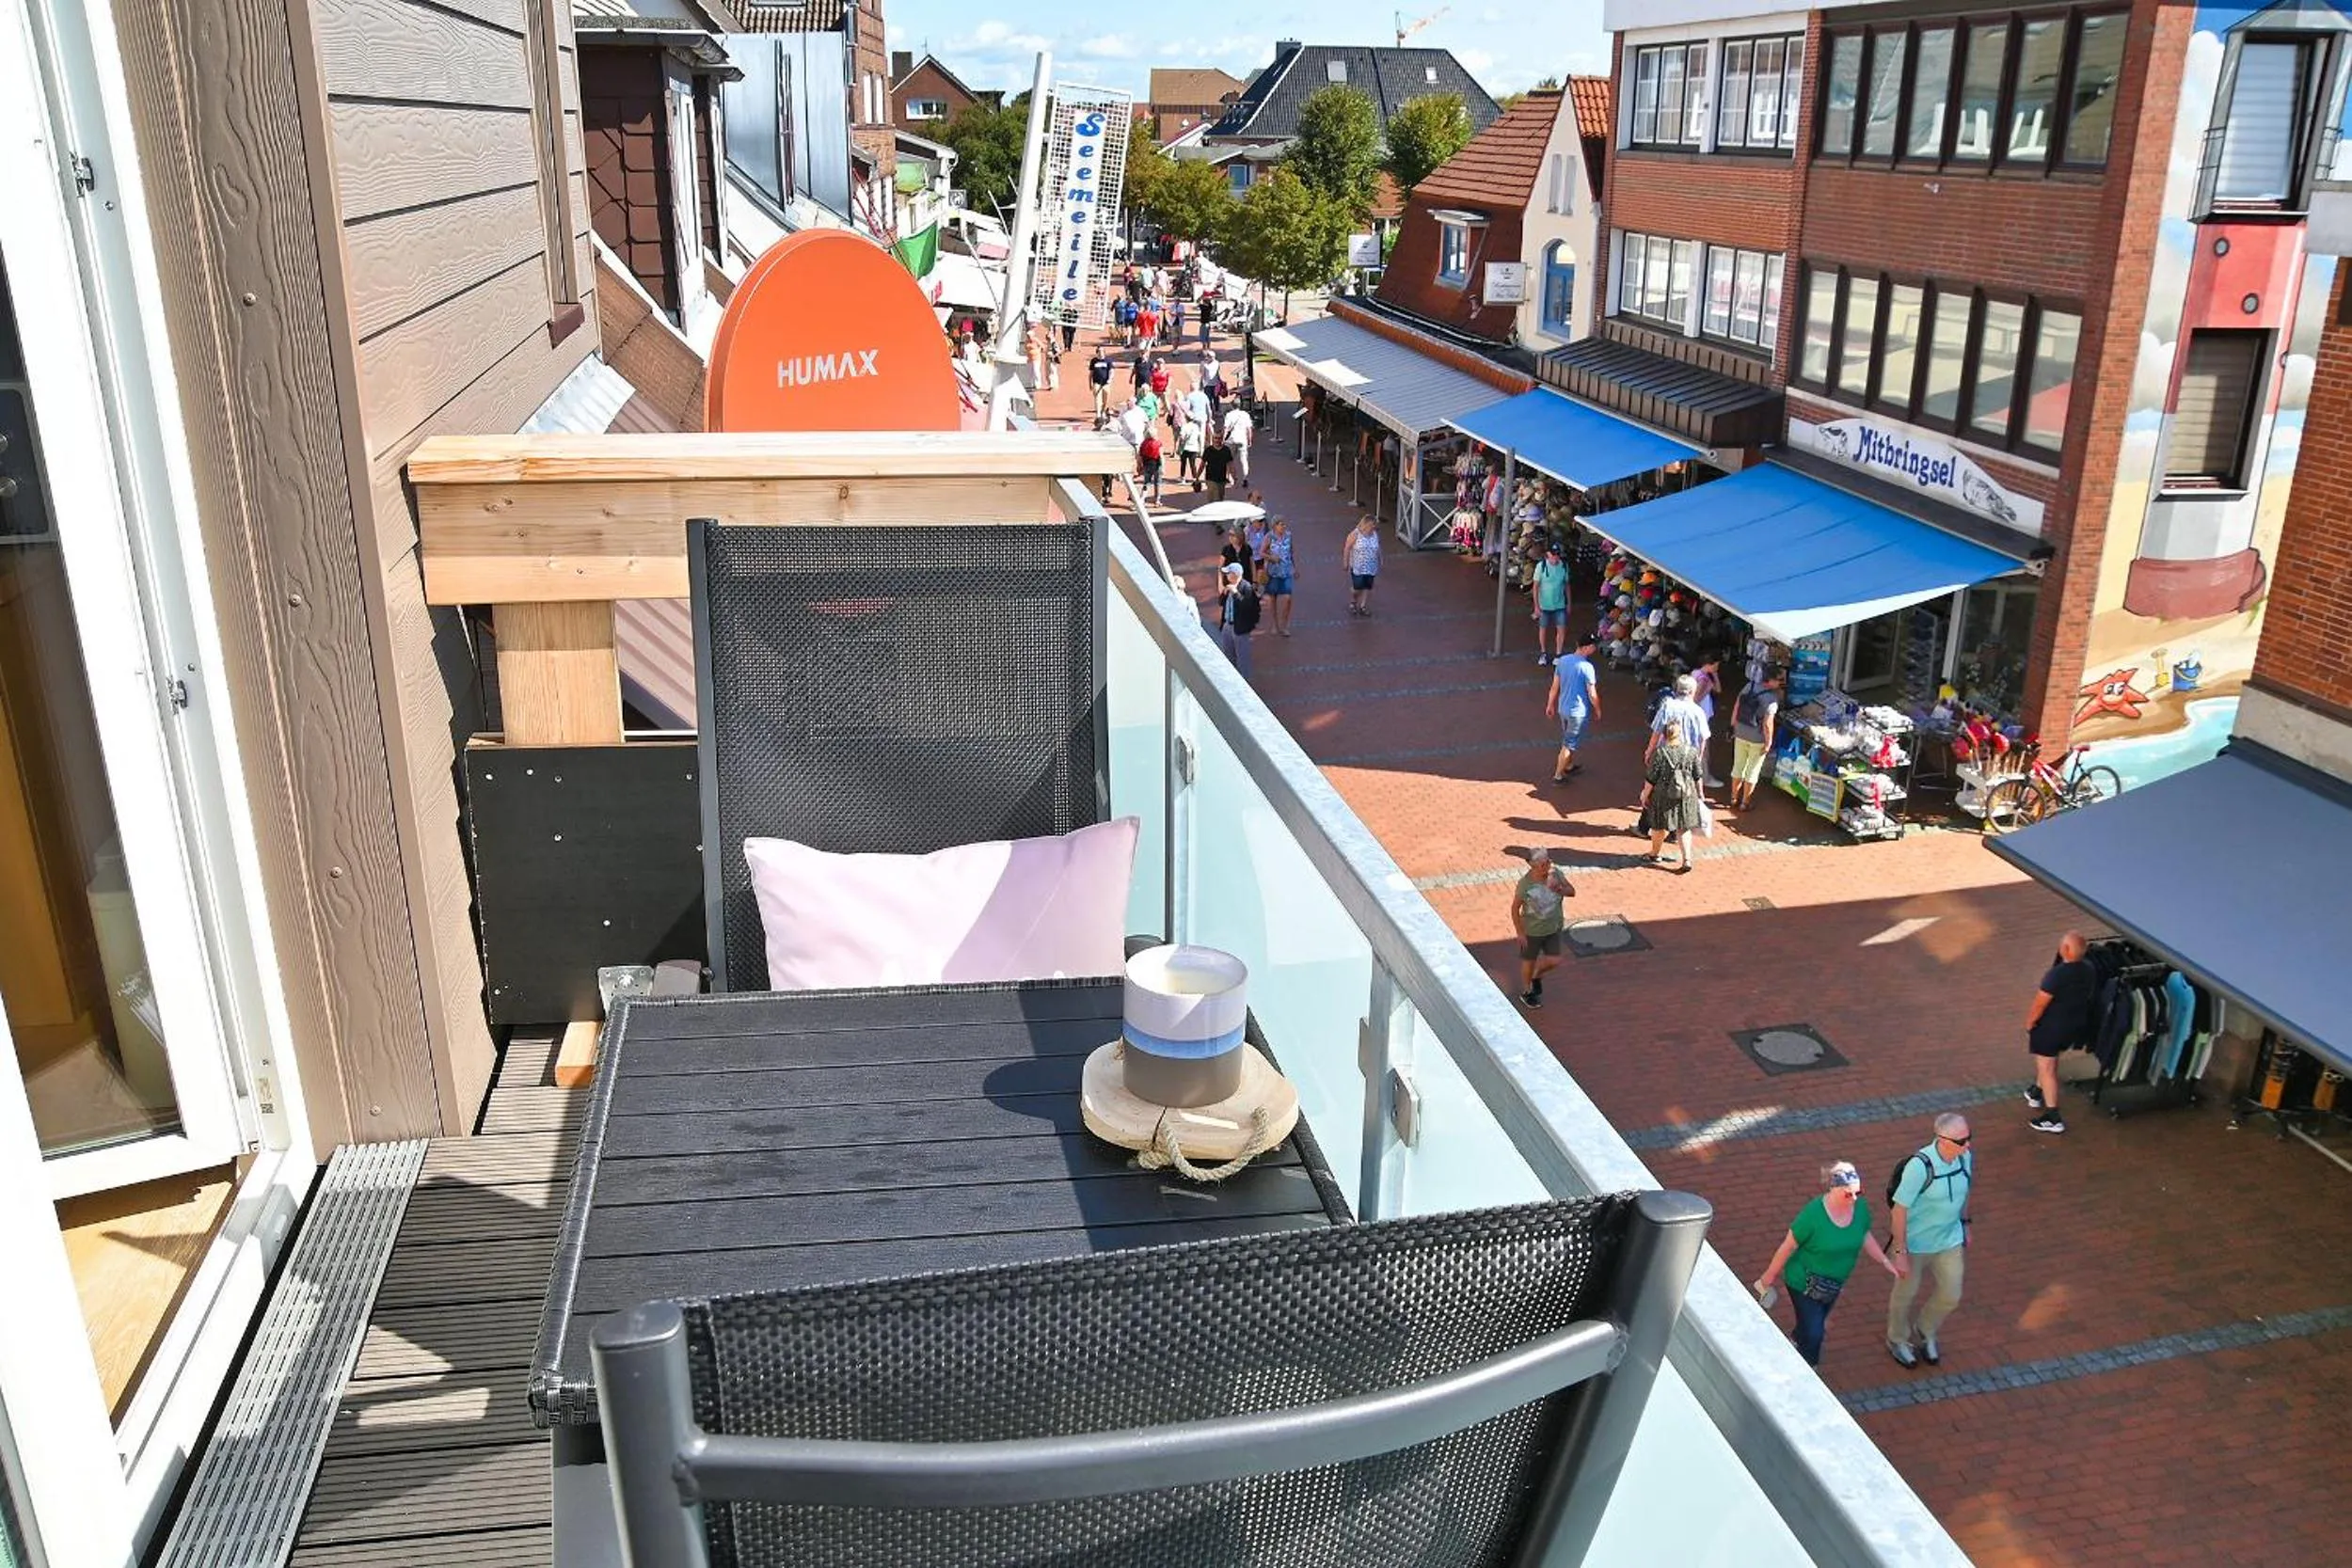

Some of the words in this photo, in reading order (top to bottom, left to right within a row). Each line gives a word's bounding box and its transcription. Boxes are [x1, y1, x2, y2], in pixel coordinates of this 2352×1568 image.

[1062, 113, 1105, 300] Seemeile
[778, 349, 879, 388] HUMAX
[1852, 425, 1957, 487] Mitbringsel
